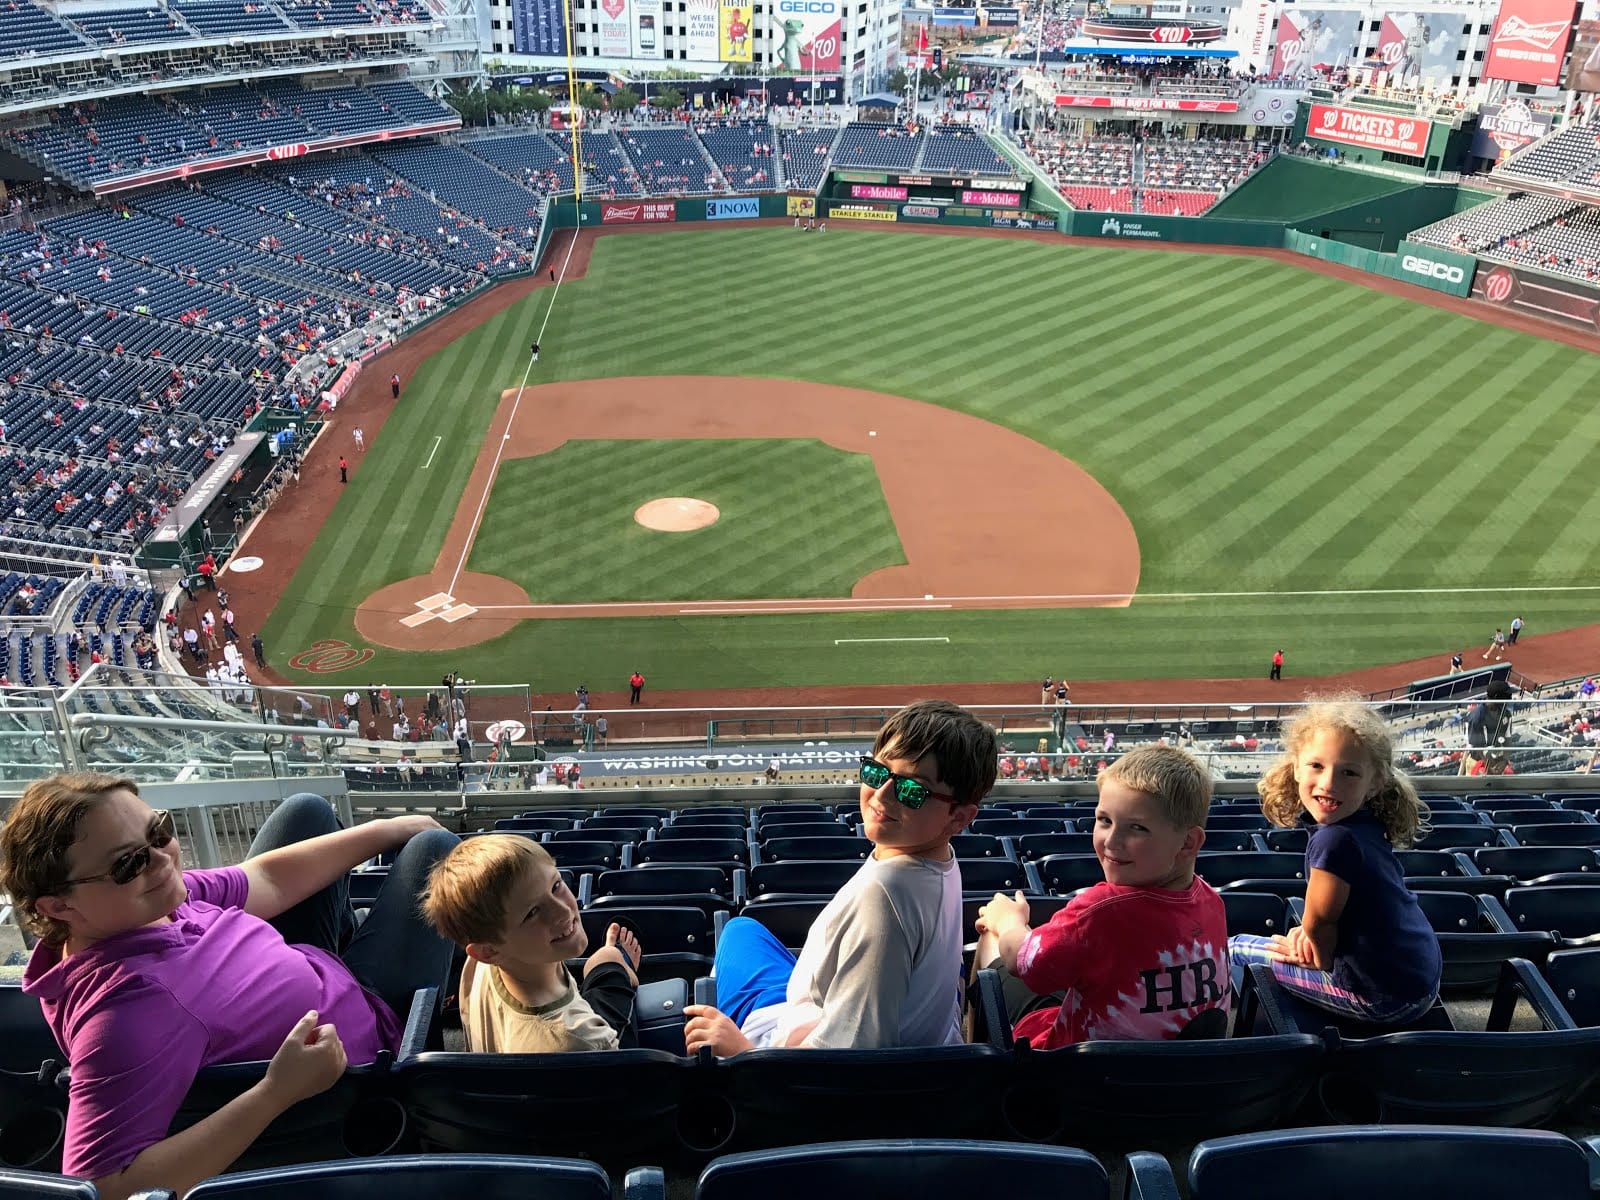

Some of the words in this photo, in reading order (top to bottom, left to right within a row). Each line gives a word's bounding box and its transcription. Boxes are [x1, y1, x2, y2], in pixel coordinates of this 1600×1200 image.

[781, 1, 835, 13] GEICO
[1341, 111, 1395, 138] TICKETS
[657, 203, 675, 211] BUD'S
[720, 203, 758, 214] INOVA
[863, 211, 894, 219] STANLEY
[1401, 255, 1464, 284] GEICO
[602, 753, 763, 770] WASHINGTON
